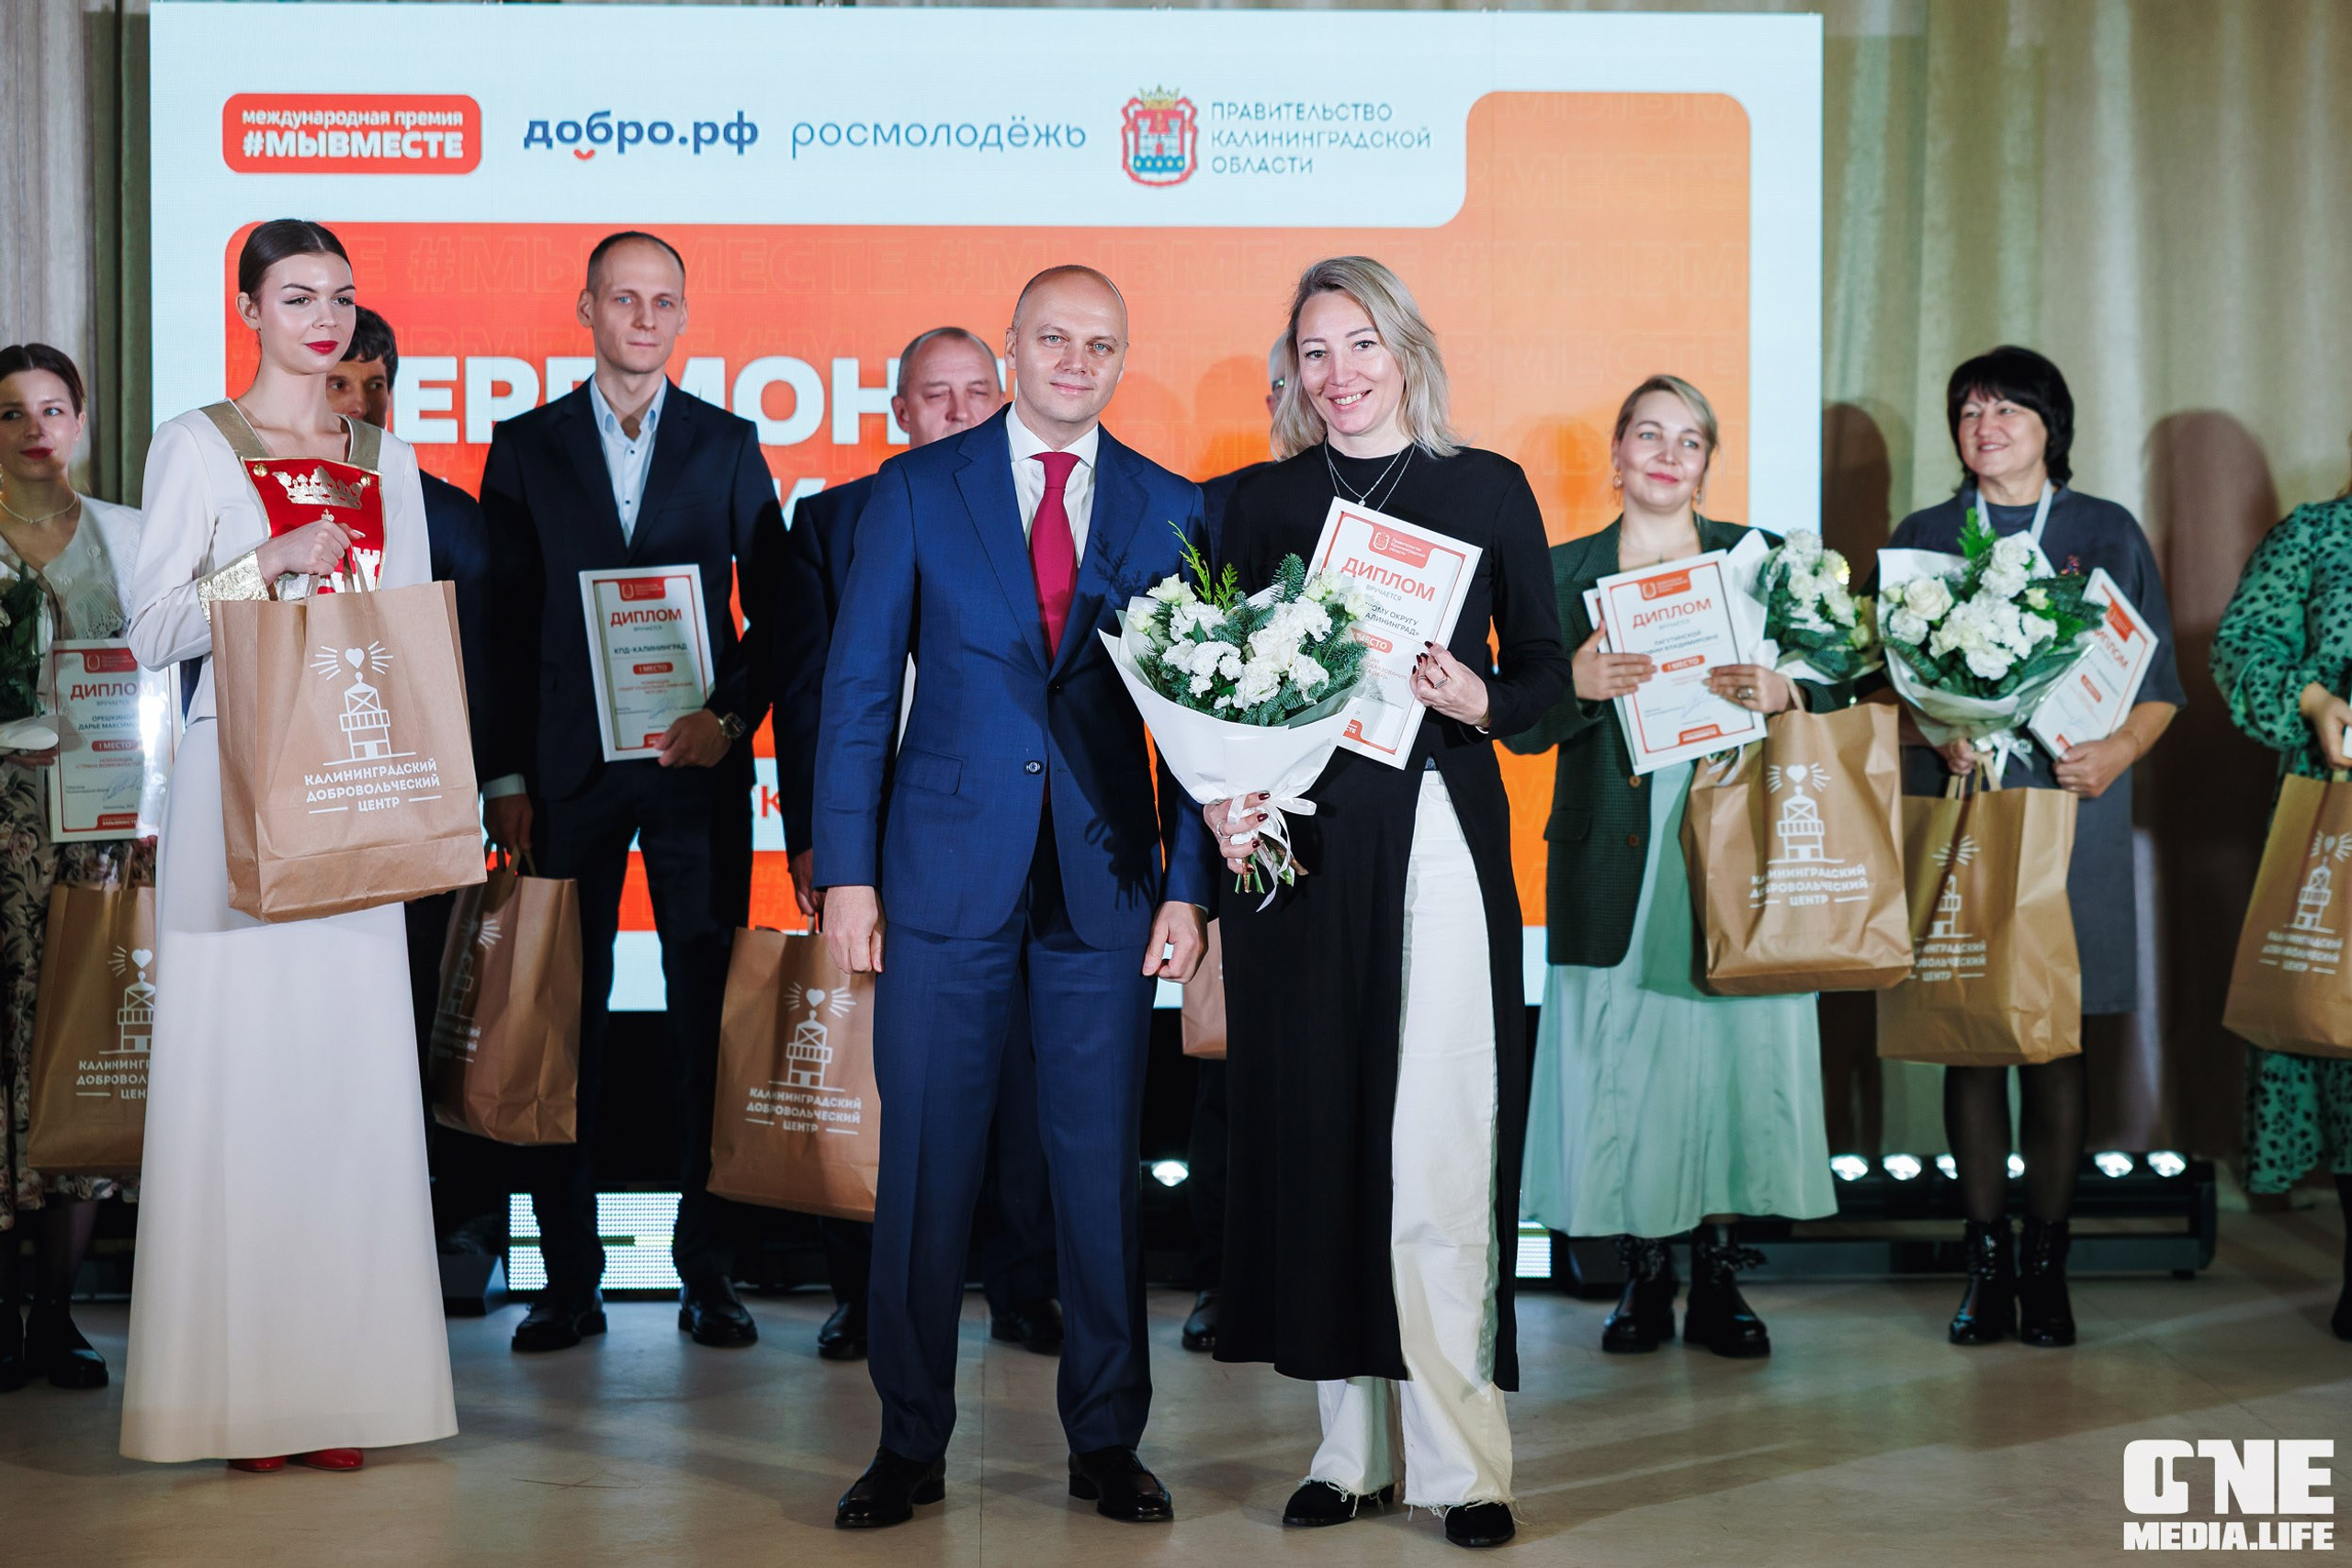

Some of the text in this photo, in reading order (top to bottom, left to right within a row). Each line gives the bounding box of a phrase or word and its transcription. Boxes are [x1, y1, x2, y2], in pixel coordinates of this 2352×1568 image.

[242, 109, 463, 130] международная премия
[1211, 102, 1393, 122] ПРАВИТЕЛЬСТВО
[524, 108, 759, 155] добро.рф
[792, 115, 1087, 161] росмолодёжь
[1211, 127, 1431, 150] КАЛИНИНГРАДСКОЙ
[242, 130, 464, 158] #МЫВМЕСТЕ
[1211, 156, 1314, 175] ОБЛАСТИ
[1340, 557, 1436, 602] ДИПЛОМ
[610, 608, 682, 627] ДИПЛОМ
[1389, 611, 1419, 626] ОКРУГУ
[1633, 598, 1712, 629] ДИПЛОМ
[1365, 612, 1419, 637] АЛИНИНГРАД»
[103, 741, 132, 750] МЕСТО
[304, 758, 437, 786] КАЛИНИНГРАДСКИЙ
[306, 773, 441, 803] ДОБРОВОЛЬЧЕСКИЙ
[357, 796, 401, 812] ЦЕНТР
[1789, 894, 1829, 907] ЦЕНТР
[76, 1074, 147, 1086] ДОБРОВОЛ
[120, 1089, 147, 1100] ЦЕН
[782, 1120, 820, 1133] ЦЕНТР
